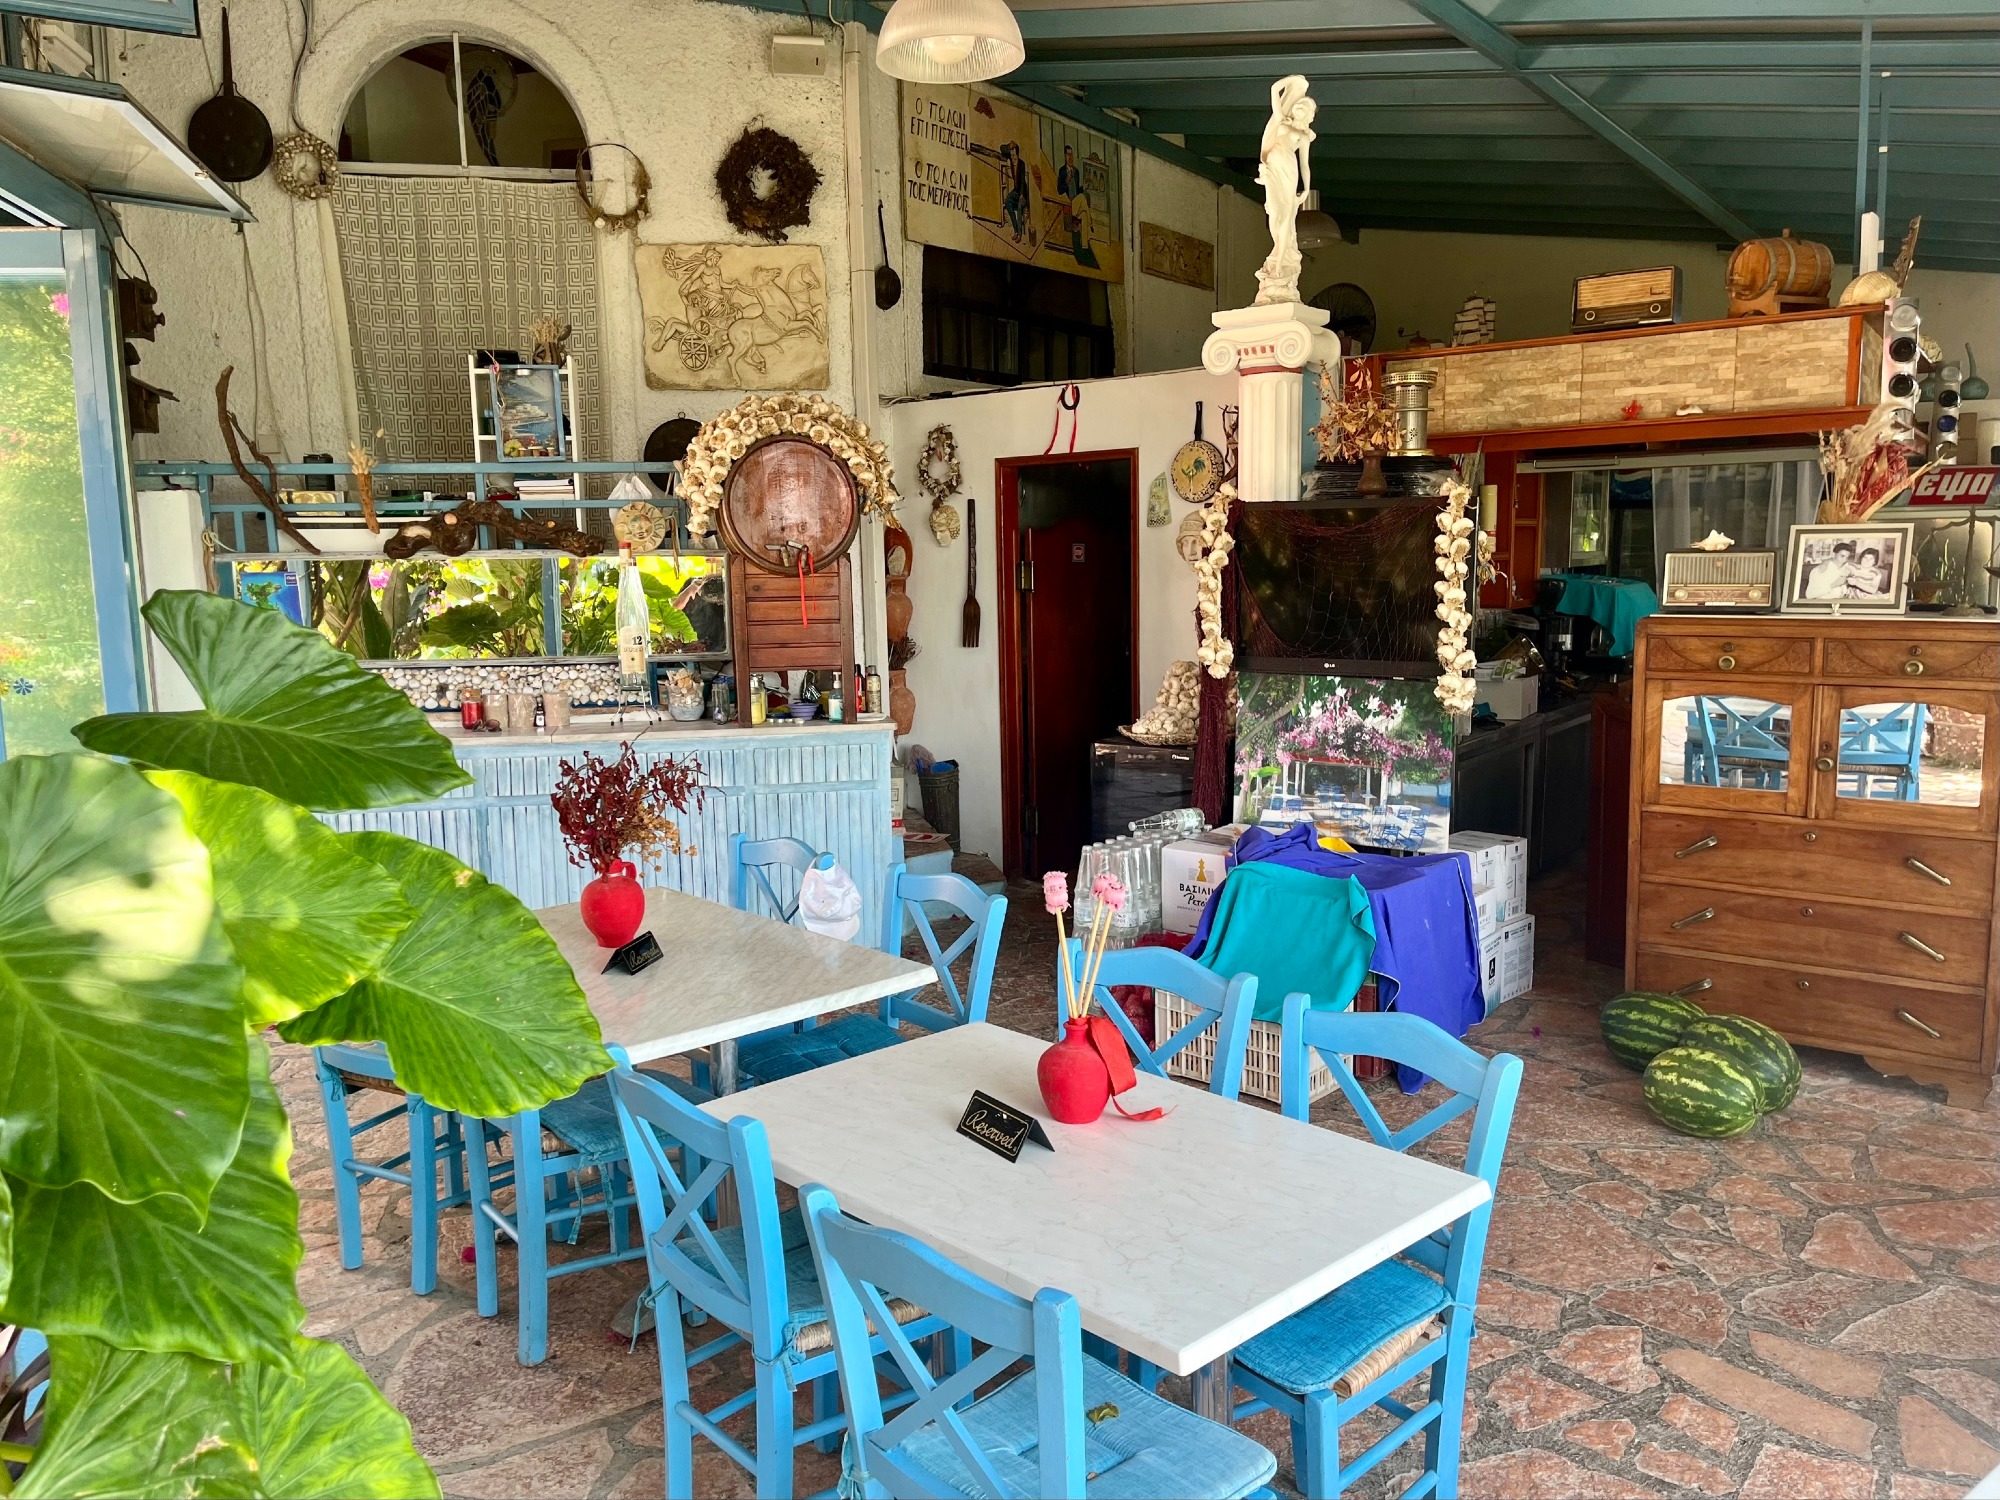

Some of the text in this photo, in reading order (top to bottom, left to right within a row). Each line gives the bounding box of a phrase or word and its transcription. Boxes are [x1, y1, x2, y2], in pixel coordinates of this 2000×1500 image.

[916, 98, 966, 130] Ο ΠΩΛΩΝ
[915, 161, 967, 192] Ο ΠΩΛΩΝ
[966, 1109, 1025, 1150] Reserved
